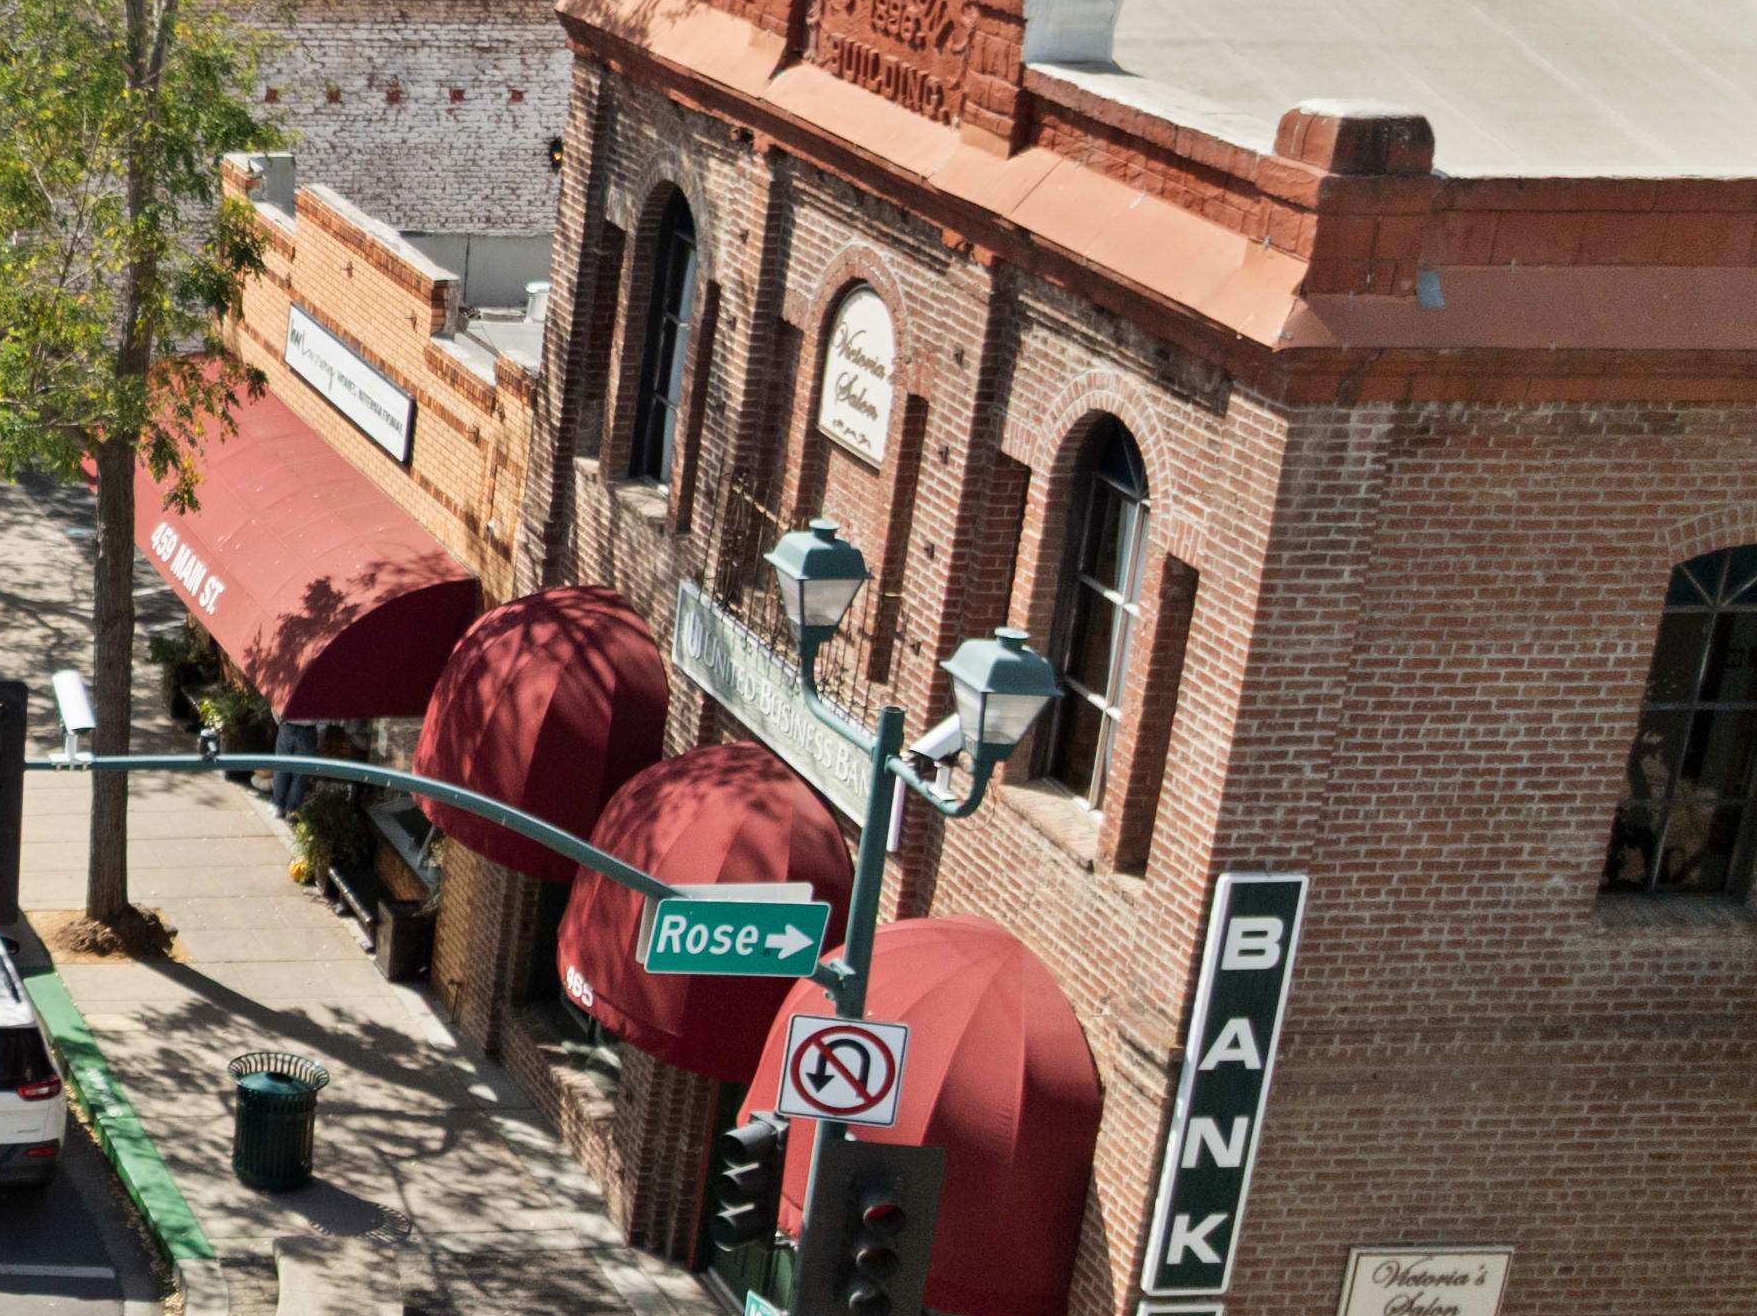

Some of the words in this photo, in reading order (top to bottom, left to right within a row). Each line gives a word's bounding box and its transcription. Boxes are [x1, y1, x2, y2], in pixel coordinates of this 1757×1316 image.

[835, 371, 878, 421] Salon
[151, 522, 177, 562] 459
[170, 543, 207, 596] MAIN
[704, 637, 756, 702] UNITED
[759, 679, 832, 768] BUSINESS
[835, 745, 870, 796] BAN
[656, 914, 759, 955] Rose
[567, 965, 593, 1007] 465
[1166, 916, 1283, 1265] BANK
[1372, 1255, 1488, 1288] Victoria's
